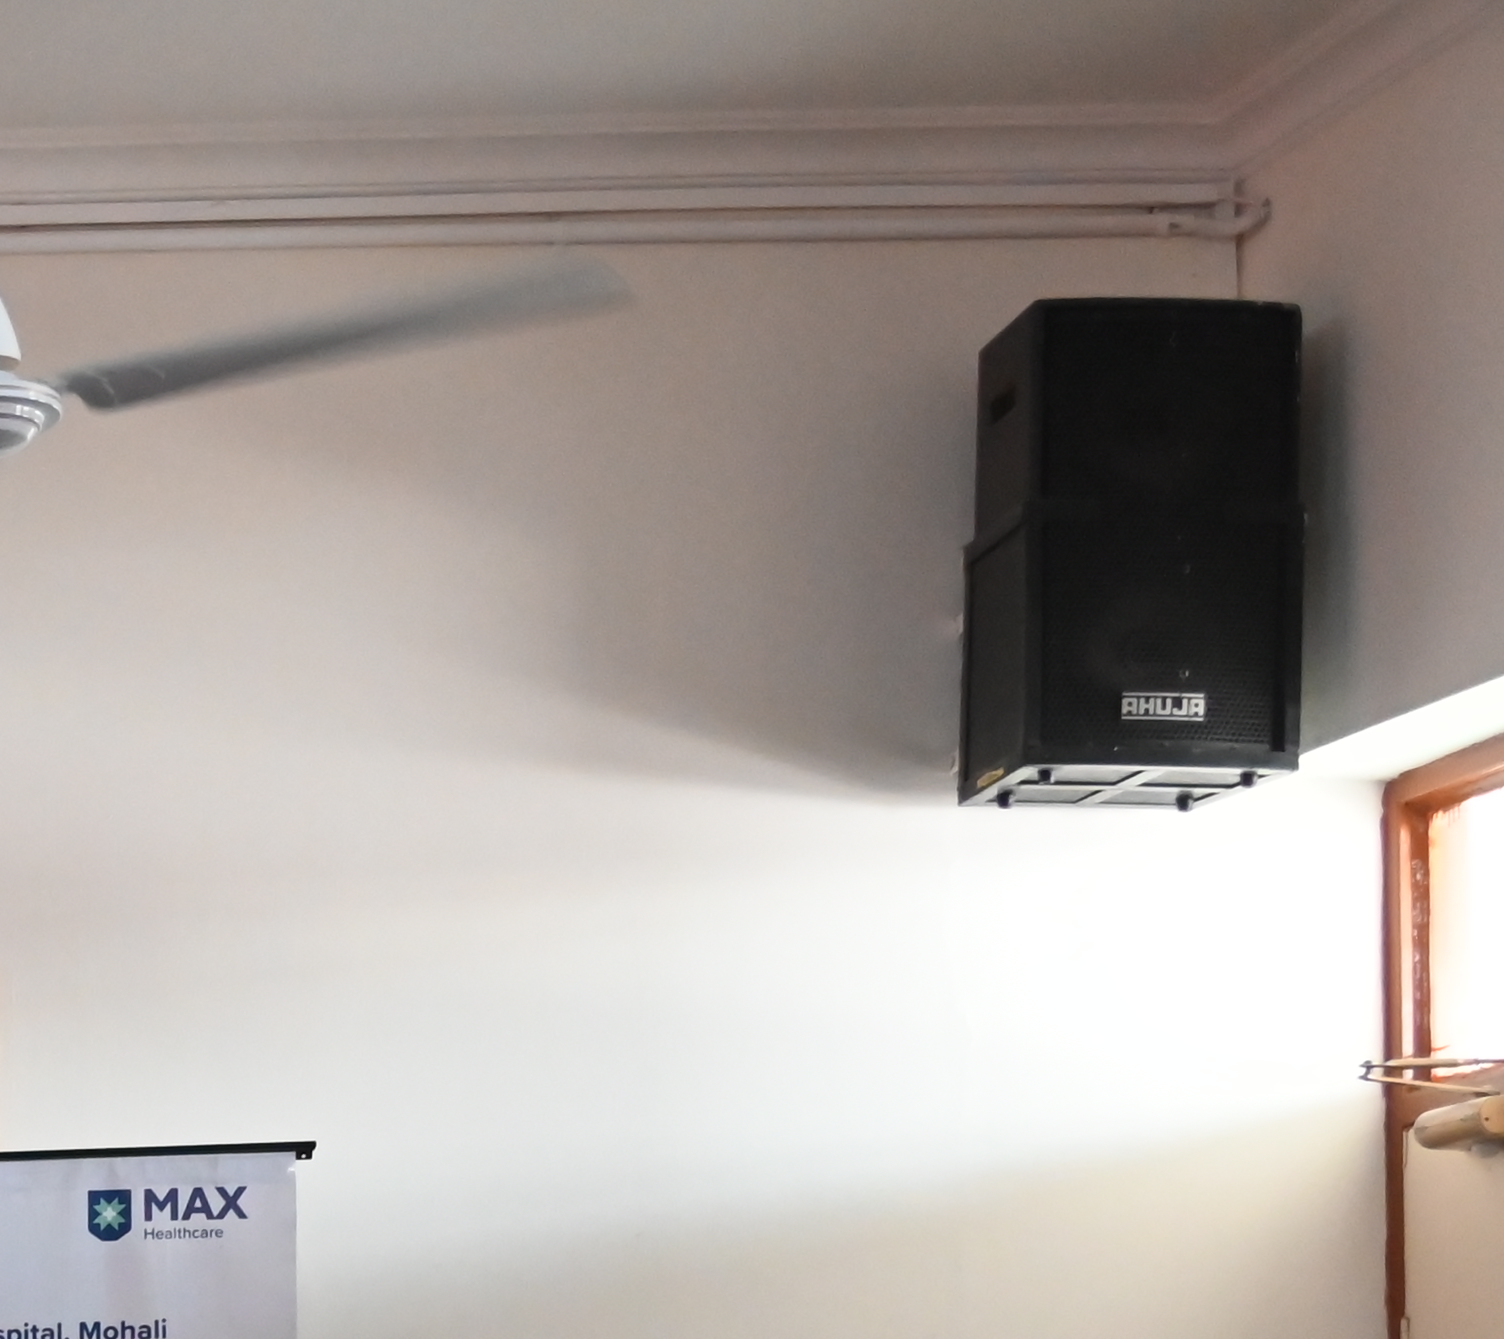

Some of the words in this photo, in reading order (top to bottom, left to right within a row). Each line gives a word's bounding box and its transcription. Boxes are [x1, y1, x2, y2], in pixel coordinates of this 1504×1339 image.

[1122, 696, 1205, 718] AHUJA
[143, 1185, 249, 1223] MAX
[143, 1225, 225, 1241] Healthcare
